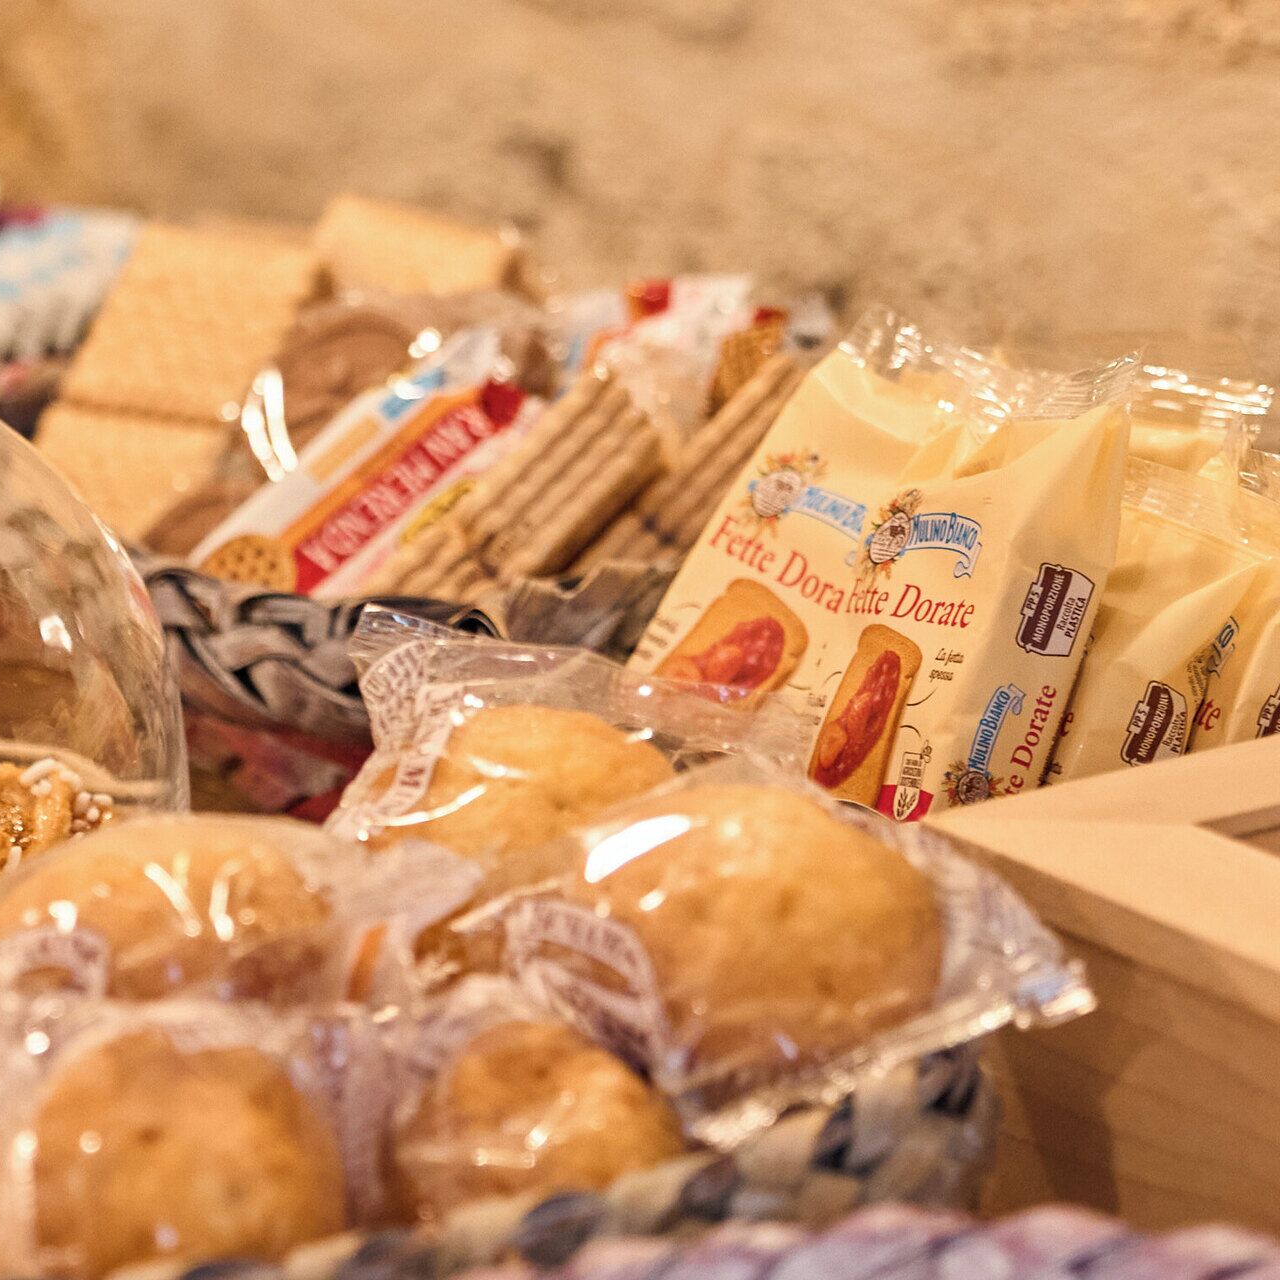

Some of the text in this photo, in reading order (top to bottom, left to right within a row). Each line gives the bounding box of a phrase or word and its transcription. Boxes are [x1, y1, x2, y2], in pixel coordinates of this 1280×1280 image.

[908, 513, 951, 545] MULINO
[946, 511, 979, 551] BIANCO
[709, 515, 777, 574] Fette
[776, 549, 845, 614] Dora
[889, 583, 975, 629] Dorate
[1032, 573, 1065, 643] MONOPORZIONE
[1056, 597, 1076, 631] Raccolta
[1064, 597, 1086, 639] PLASTICA
[968, 690, 1011, 771] MULINO BIANCO
[1010, 685, 1057, 770] Dorate
